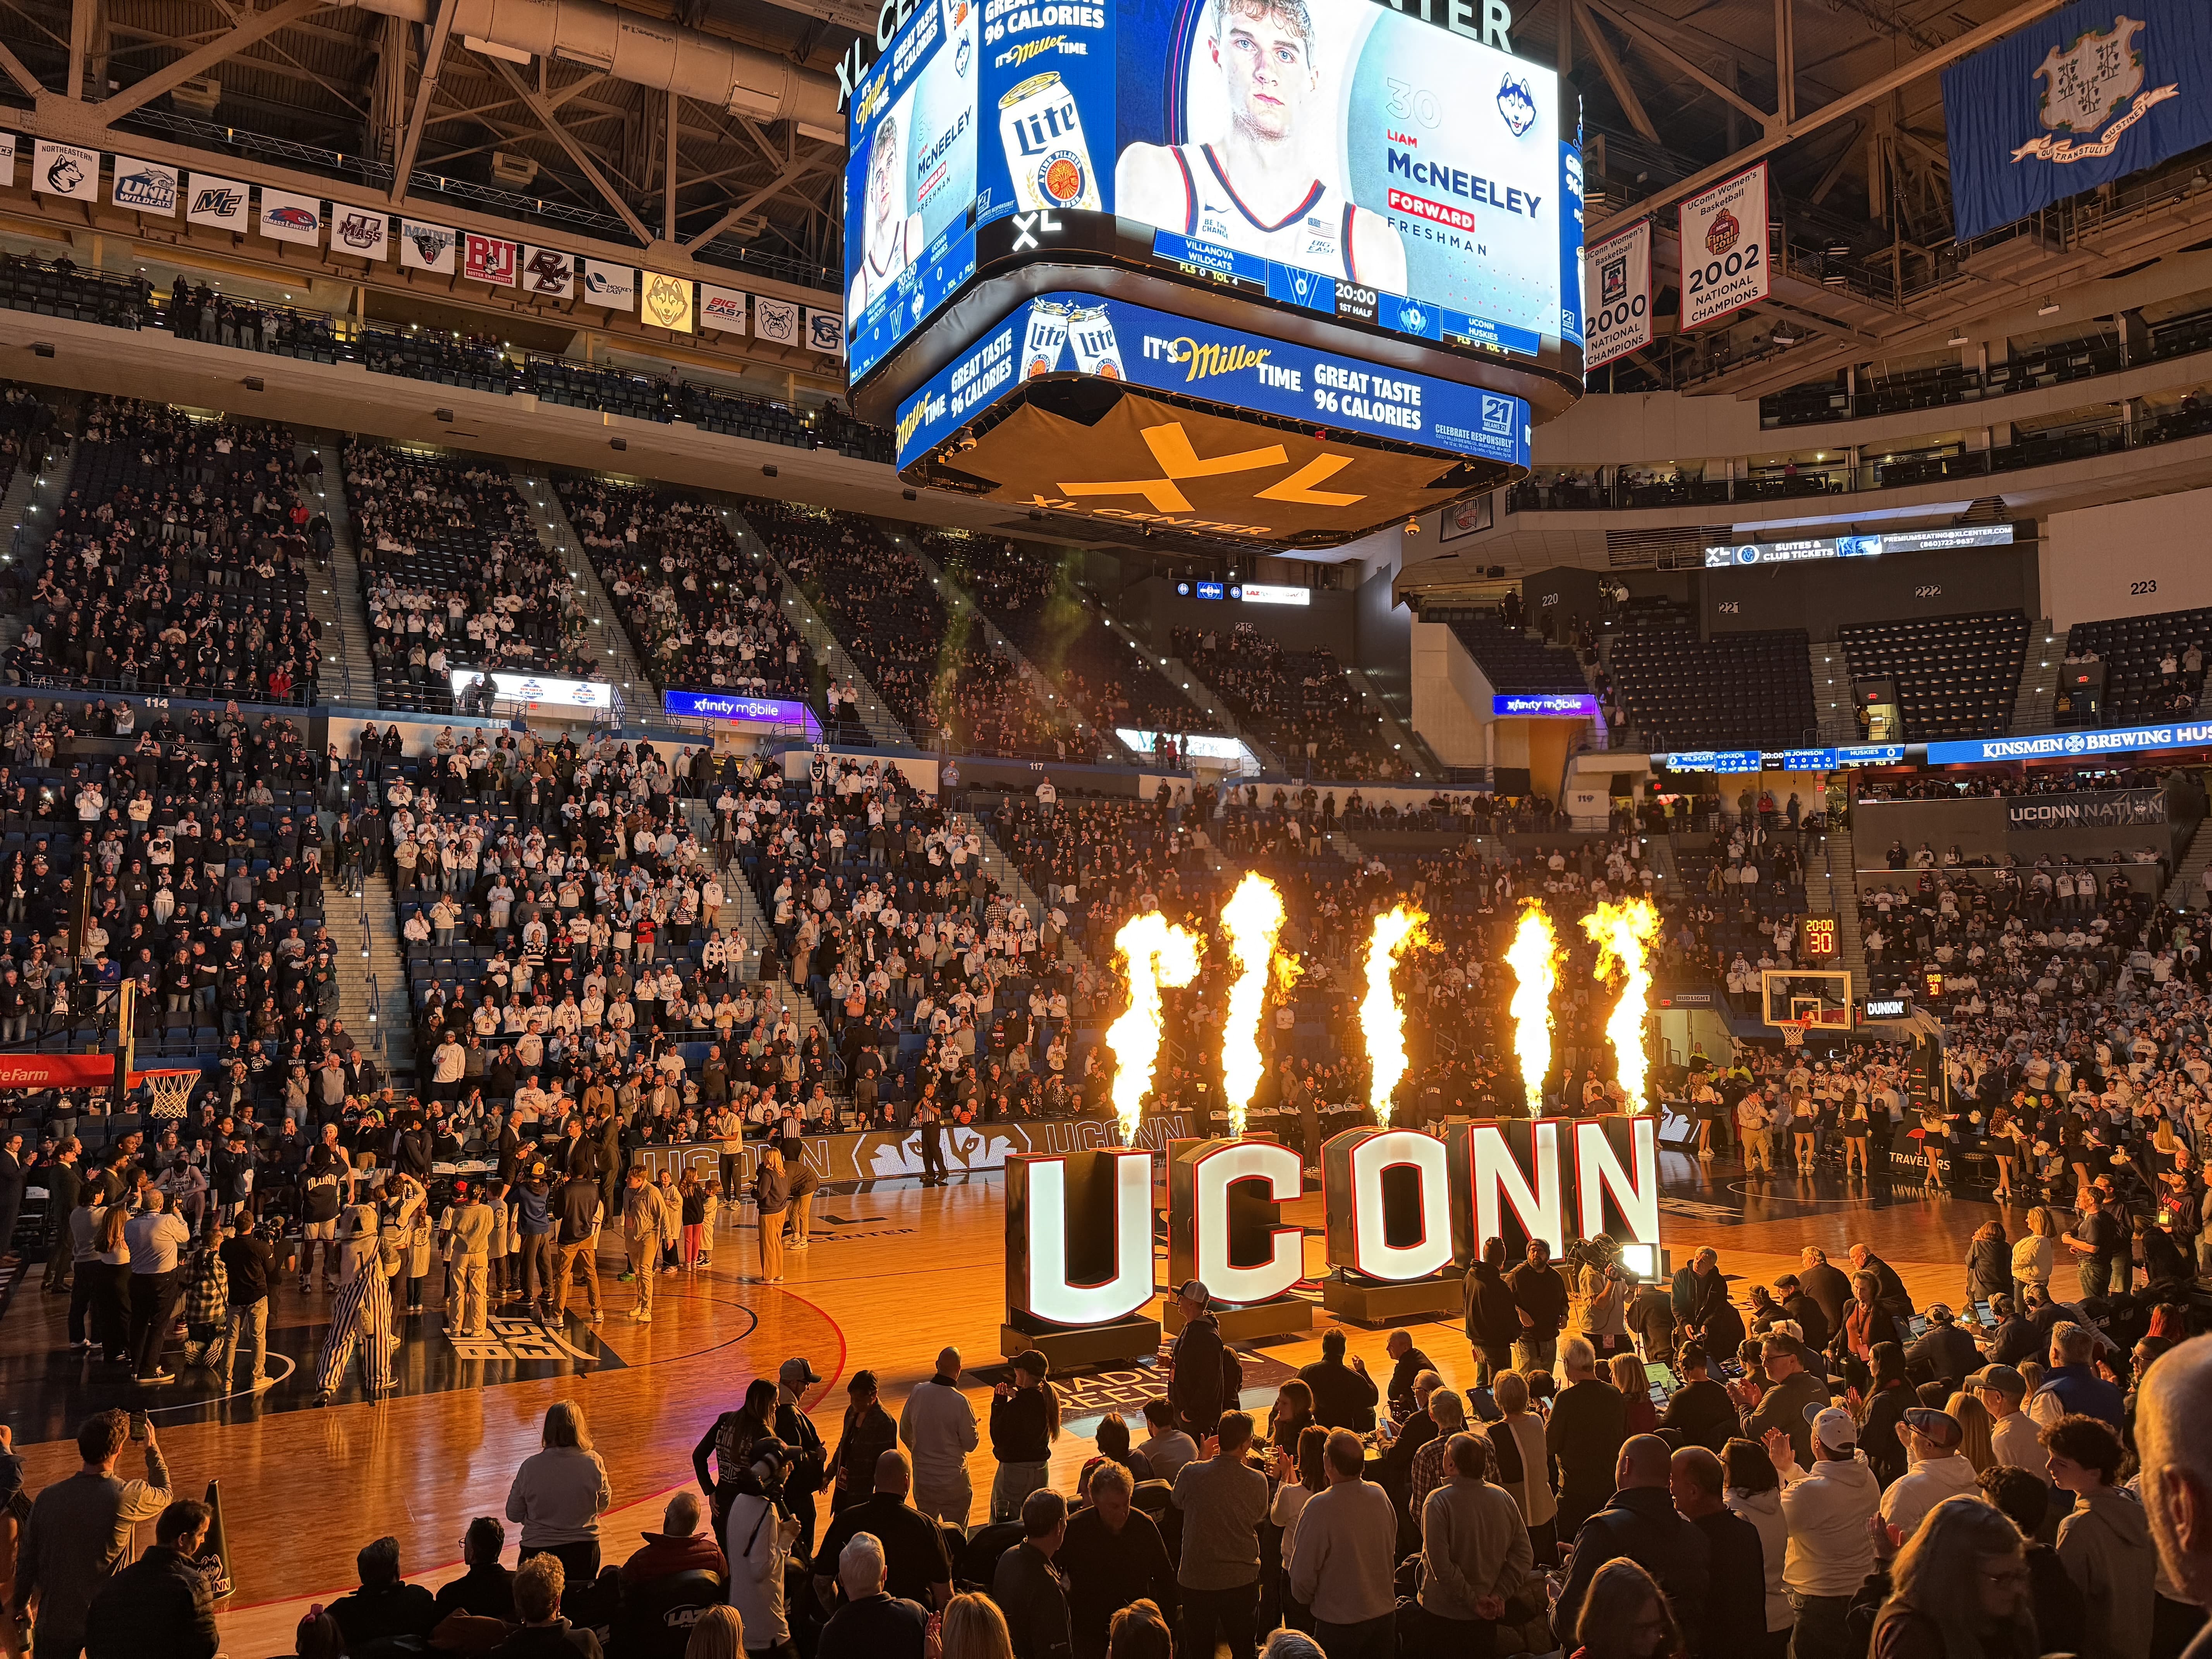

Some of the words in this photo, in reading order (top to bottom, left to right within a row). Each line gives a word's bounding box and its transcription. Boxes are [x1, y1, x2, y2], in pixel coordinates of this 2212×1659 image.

[985, 19, 1005, 46] 96
[1007, 5, 1105, 34] CALORIES
[893, 64, 903, 86] 96
[904, 18, 938, 73] CALORIES
[894, 26, 915, 67] GREAT
[995, 49, 1013, 69] IT'S
[1010, 34, 1067, 68] Miller
[835, 37, 868, 113] XL
[1386, 77, 1442, 130] 30
[1012, 102, 1077, 156] Lite
[1387, 128, 1418, 149] LIAM
[2041, 148, 2054, 157] QUI
[2056, 144, 2109, 161] TRANSTULIT
[2105, 105, 2145, 141] SUSTINET
[917, 105, 972, 180] McNEELEY
[41, 145, 93, 162] NORTHEASTERN
[918, 163, 946, 199] FORWARD
[1388, 148, 1542, 219] McNEELEY
[1688, 192, 1715, 210] UConn
[1717, 171, 1757, 195] Women's
[118, 193, 172, 208] WILDCATS
[917, 176, 951, 216] FRESHMAN
[1700, 188, 1744, 216] Basketball
[1390, 192, 1473, 229] FORWARD
[337, 222, 382, 242] MASS
[1012, 210, 1062, 252] XL
[1202, 225, 1230, 240] CHANGE
[1204, 218, 1215, 227] BE
[403, 224, 455, 246] MAINE
[1312, 240, 1330, 250] BIG
[1388, 217, 1487, 256] FRESHMAN
[1585, 246, 1608, 261] UConn
[1609, 227, 1644, 249] Women's
[1706, 225, 1734, 249] Final
[1713, 233, 1740, 256] Four
[466, 236, 517, 273] BU
[1185, 239, 1234, 261] VILLANOVA
[1309, 245, 1336, 254] EAST
[1595, 242, 1633, 267] Basketball
[1188, 251, 1232, 271] WILDCATS
[1689, 244, 1760, 295] 2002
[468, 270, 484, 278] BOSTON
[484, 273, 512, 283] UNIVERSITY
[897, 262, 917, 292] 20:00
[1180, 263, 1196, 275] FLS
[1199, 267, 1206, 277] 0
[1211, 270, 1229, 284] TOL
[606, 288, 623, 296] EAST
[607, 283, 633, 293] HOCKEY
[1335, 282, 1376, 306] 20:00
[1695, 275, 1753, 306] NATIONAL
[705, 304, 745, 318] EAST
[710, 297, 737, 309] BIG
[1339, 302, 1352, 314] 1ST
[1353, 305, 1373, 318] HALF
[1691, 287, 1758, 322] CHAMPIONS
[712, 314, 740, 323] CONFERENCE
[1468, 317, 1495, 331] UCONN
[1585, 294, 1646, 340] 2000
[1029, 323, 1066, 351] Lite
[1077, 328, 1114, 358] Lite
[1457, 335, 1472, 346] FLS
[1486, 342, 1500, 354] TOL
[1468, 327, 1498, 342] HUSKIES
[1591, 323, 1640, 351] NATIONAL
[1143, 335, 1178, 364] IT'S
[1173, 337, 1271, 383] Miller
[1588, 334, 1644, 365] CHAMPIONS
[951, 356, 981, 393] GREAT
[980, 328, 1012, 363] TASTE
[951, 395, 964, 418] 96
[965, 356, 1012, 407] CALORIES
[1314, 363, 1369, 392] GREAT
[1371, 376, 1421, 407] TASTE
[1314, 390, 1339, 413] 96
[1341, 398, 1422, 431] CALORIES
[1484, 399, 1510, 424] 21
[1435, 423, 1470, 440] CELEBRATE
[1484, 421, 1500, 430] MEANS
[1017, 493, 1079, 510] XL
[1092, 508, 1272, 536] CENTER
[1883, 527, 2011, 543] PREMIUMSEATING@XLCENTER.COM
[1706, 547, 1731, 563] XL
[1763, 551, 1790, 562] CLUB
[1791, 548, 1835, 559] TICKETS
[1775, 541, 1812, 552] SUITES
[1915, 585, 1941, 598] 222
[2130, 579, 2157, 596] 223
[1542, 592, 1559, 607] 220
[1719, 601, 1740, 614] 221
[1236, 623, 1254, 633] 219
[144, 697, 168, 709] 114
[694, 699, 733, 714] xfinity
[735, 702, 778, 718] mobile
[1506, 699, 1542, 711] xfinity
[486, 719, 508, 729] 115
[812, 743, 830, 753] 116
[1886, 748, 1896, 757] 0
[1982, 738, 2064, 759] KINSMEN
[2086, 729, 2172, 750] BREWING
[1029, 763, 1044, 771] 117
[1577, 795, 1594, 803] 119
[2010, 804, 2080, 822] UCONN
[1993, 870, 2006, 879] 12
[1805, 919, 1834, 932] 20:00
[1810, 933, 1832, 954] 30
[1929, 983, 1939, 995] 30
[1889, 1152, 1951, 1171] TRAVELRS
[307, 1174, 337, 1192] UCONN
[1026, 1115, 1661, 1327] UCONN
